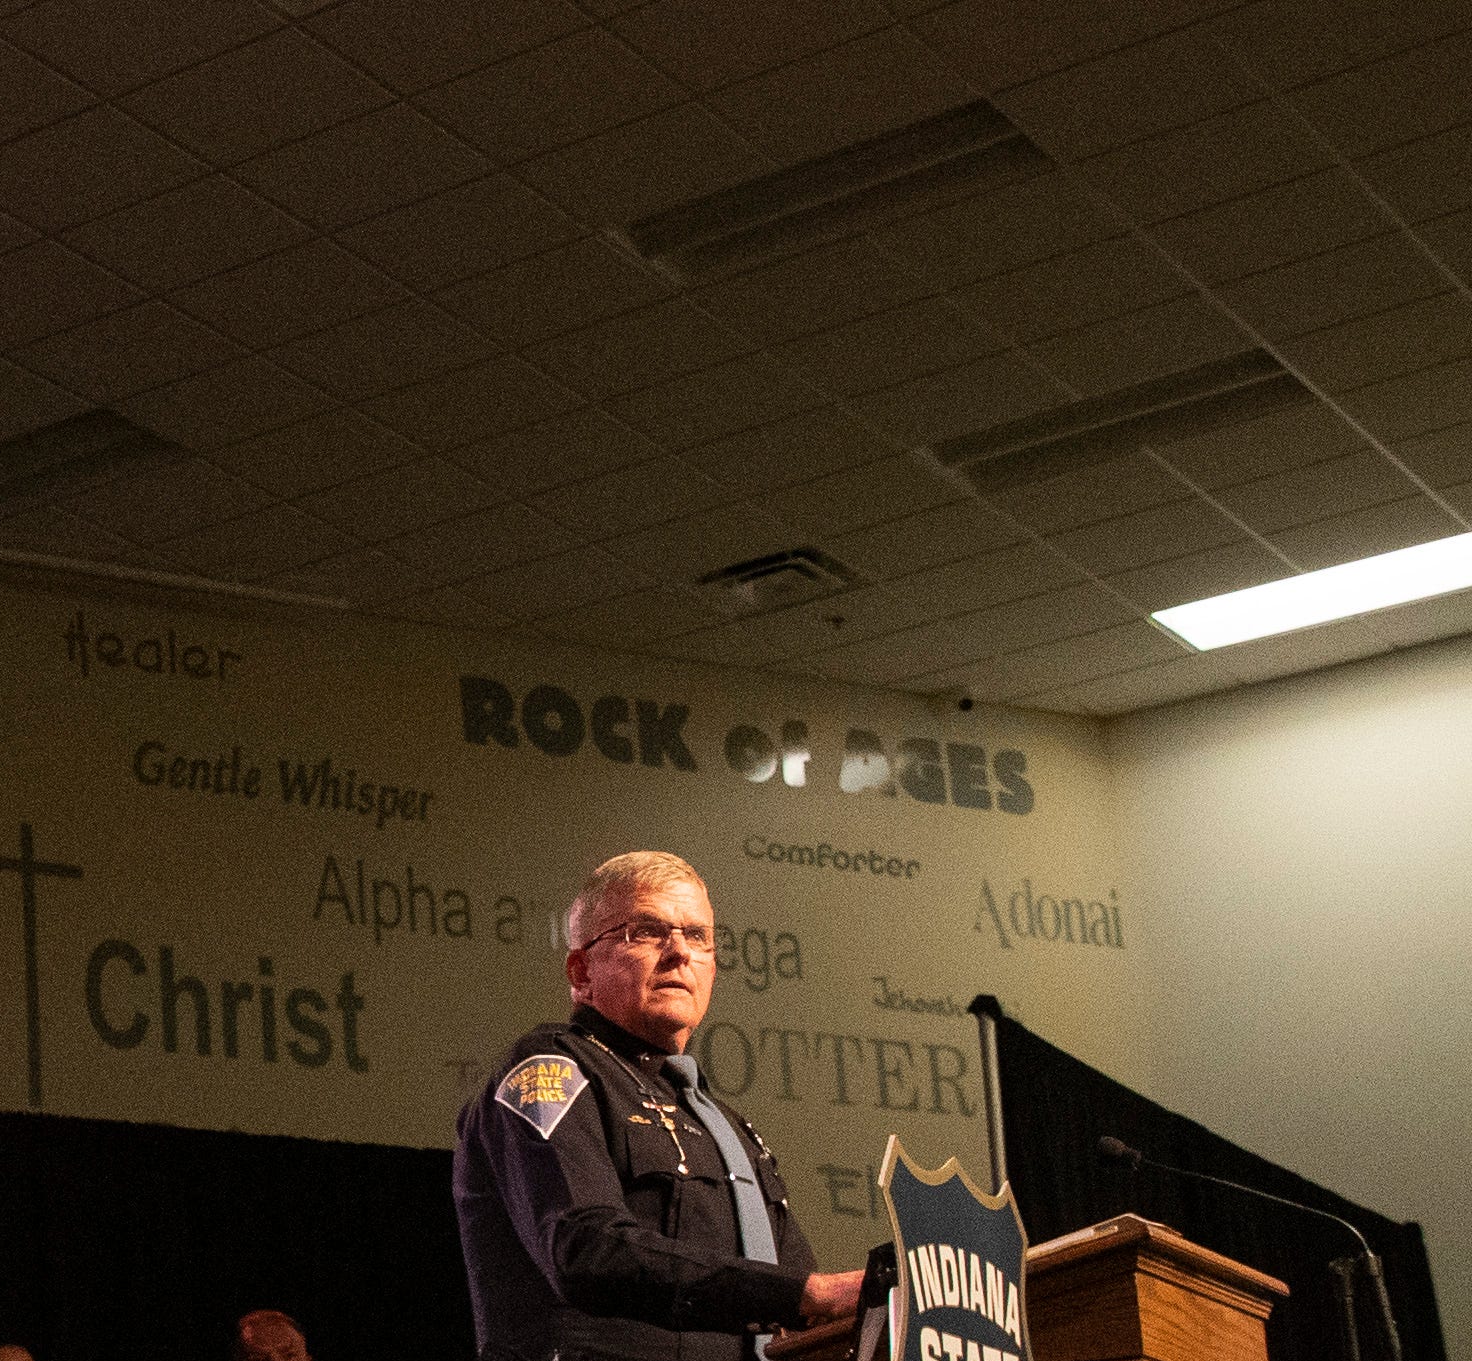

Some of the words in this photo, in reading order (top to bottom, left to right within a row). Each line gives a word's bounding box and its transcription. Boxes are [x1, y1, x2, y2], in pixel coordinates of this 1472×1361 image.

[64, 610, 242, 681] Healer
[132, 740, 260, 798] Gentle
[278, 757, 434, 829] Whisper
[460, 675, 698, 774] ROCK
[839, 728, 1034, 814] AGES
[742, 834, 921, 879] Comforter
[312, 855, 473, 946] Alpha
[714, 922, 804, 992] ega
[973, 876, 1126, 949] Adonai
[84, 939, 370, 1074] Christ
[506, 1062, 573, 1090] INDIANA
[519, 1075, 563, 1094] STATE
[519, 1089, 568, 1108] POLICE
[700, 1021, 978, 1118] OTTER
[908, 1243, 1022, 1348] INDIANA
